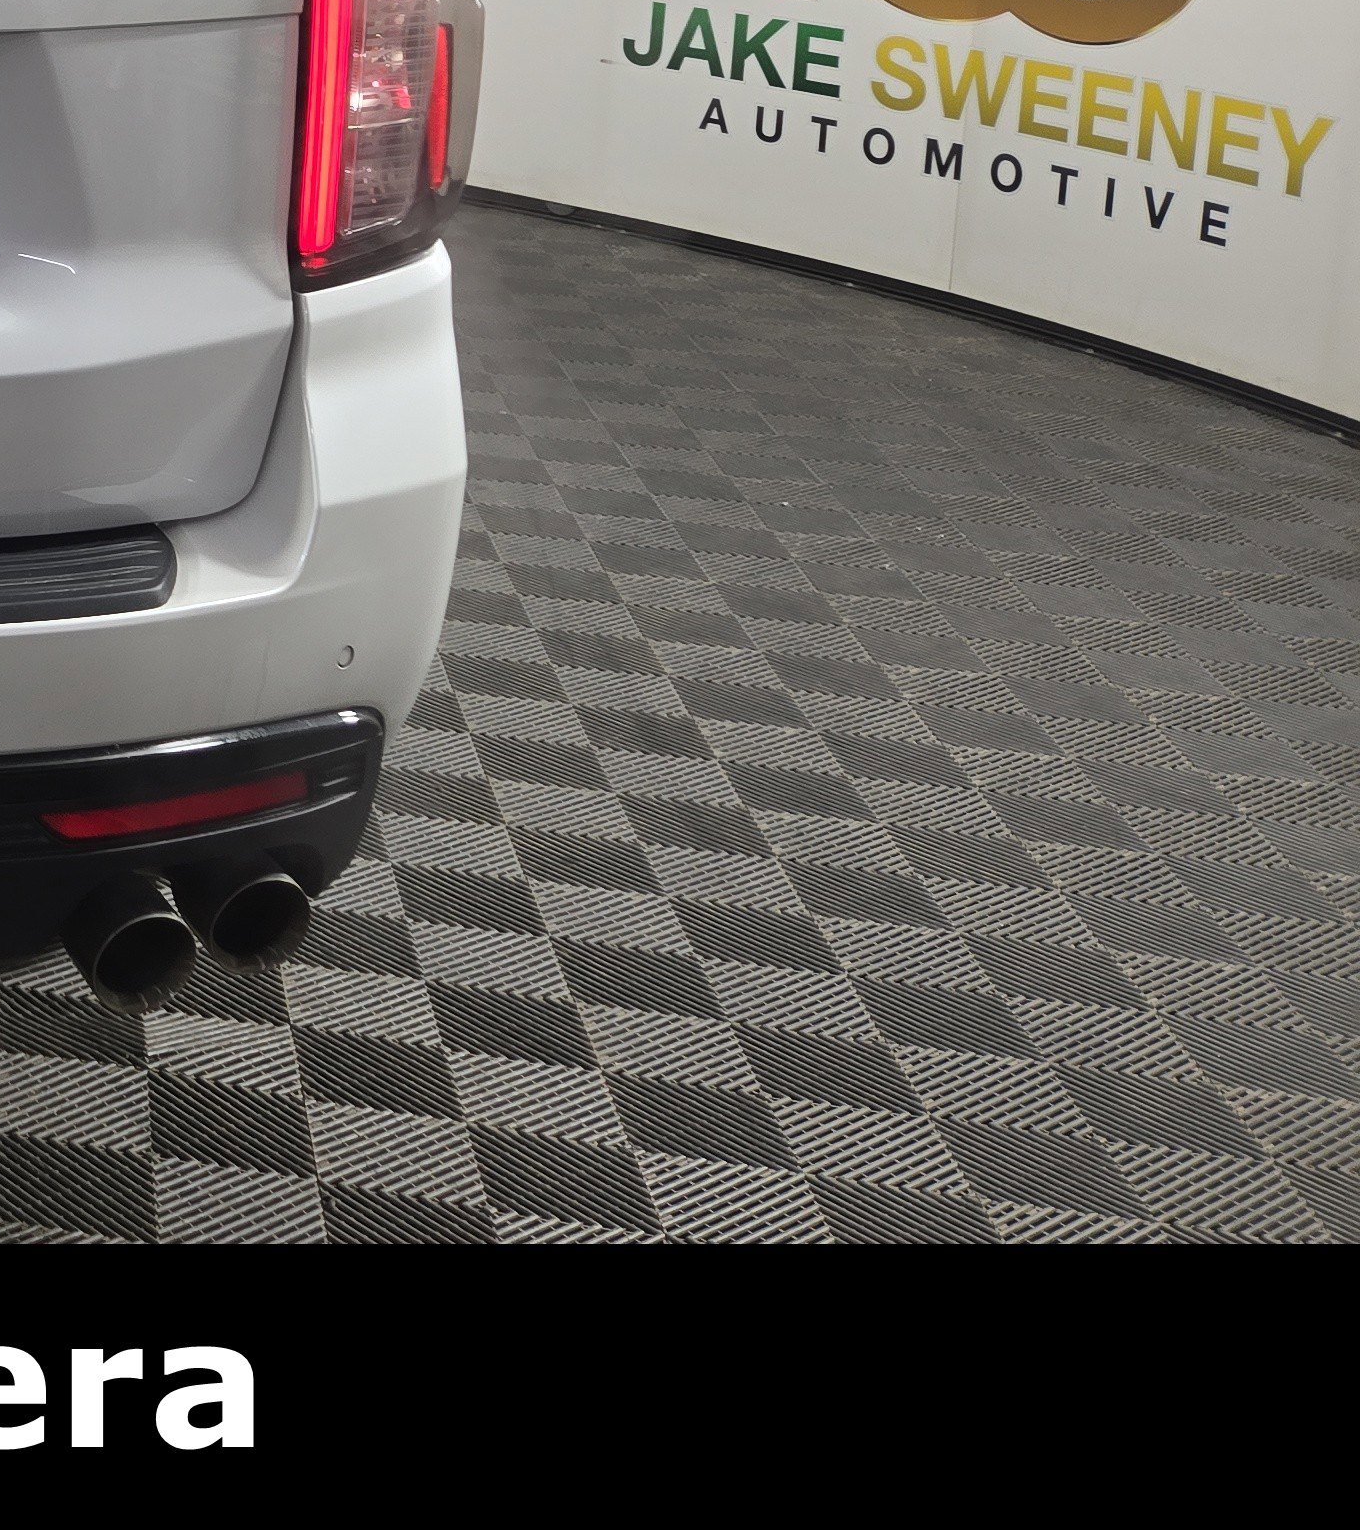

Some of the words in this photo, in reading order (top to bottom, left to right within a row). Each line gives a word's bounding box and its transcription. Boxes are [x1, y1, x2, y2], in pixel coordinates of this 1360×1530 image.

[622, 1, 845, 98] JAKE
[870, 35, 1333, 197] SWEENEY
[698, 97, 1231, 247] AUTOMOTIVE
